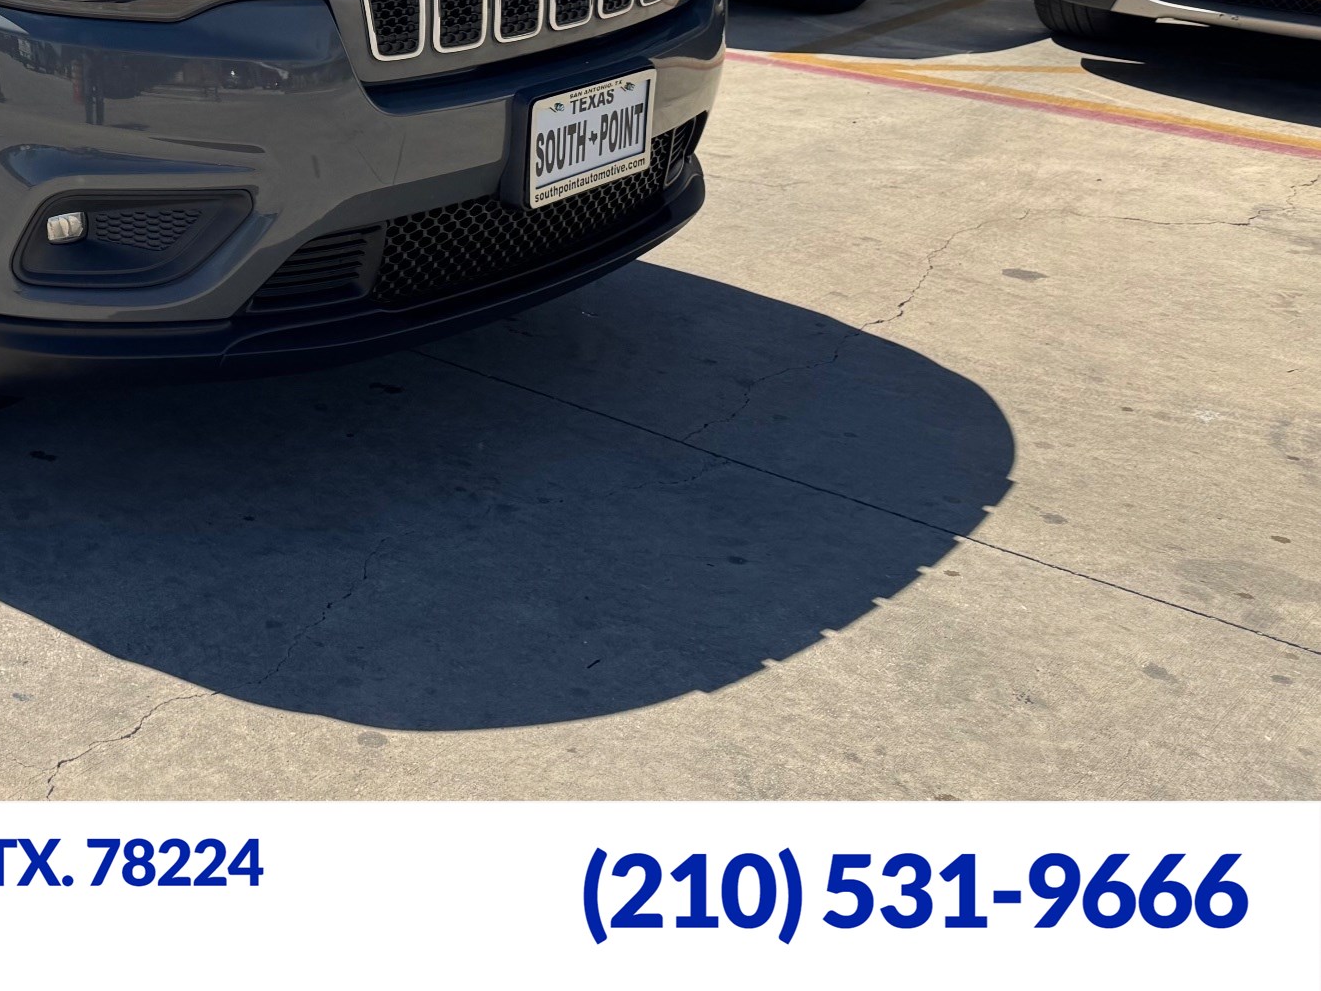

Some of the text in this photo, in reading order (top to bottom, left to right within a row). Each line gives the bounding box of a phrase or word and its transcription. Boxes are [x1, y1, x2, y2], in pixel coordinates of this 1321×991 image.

[569, 90, 583, 99] SAN
[570, 88, 615, 114] TEXAS
[535, 102, 644, 177] SOUTH POINT
[534, 157, 646, 204] southpointautomotive.com
